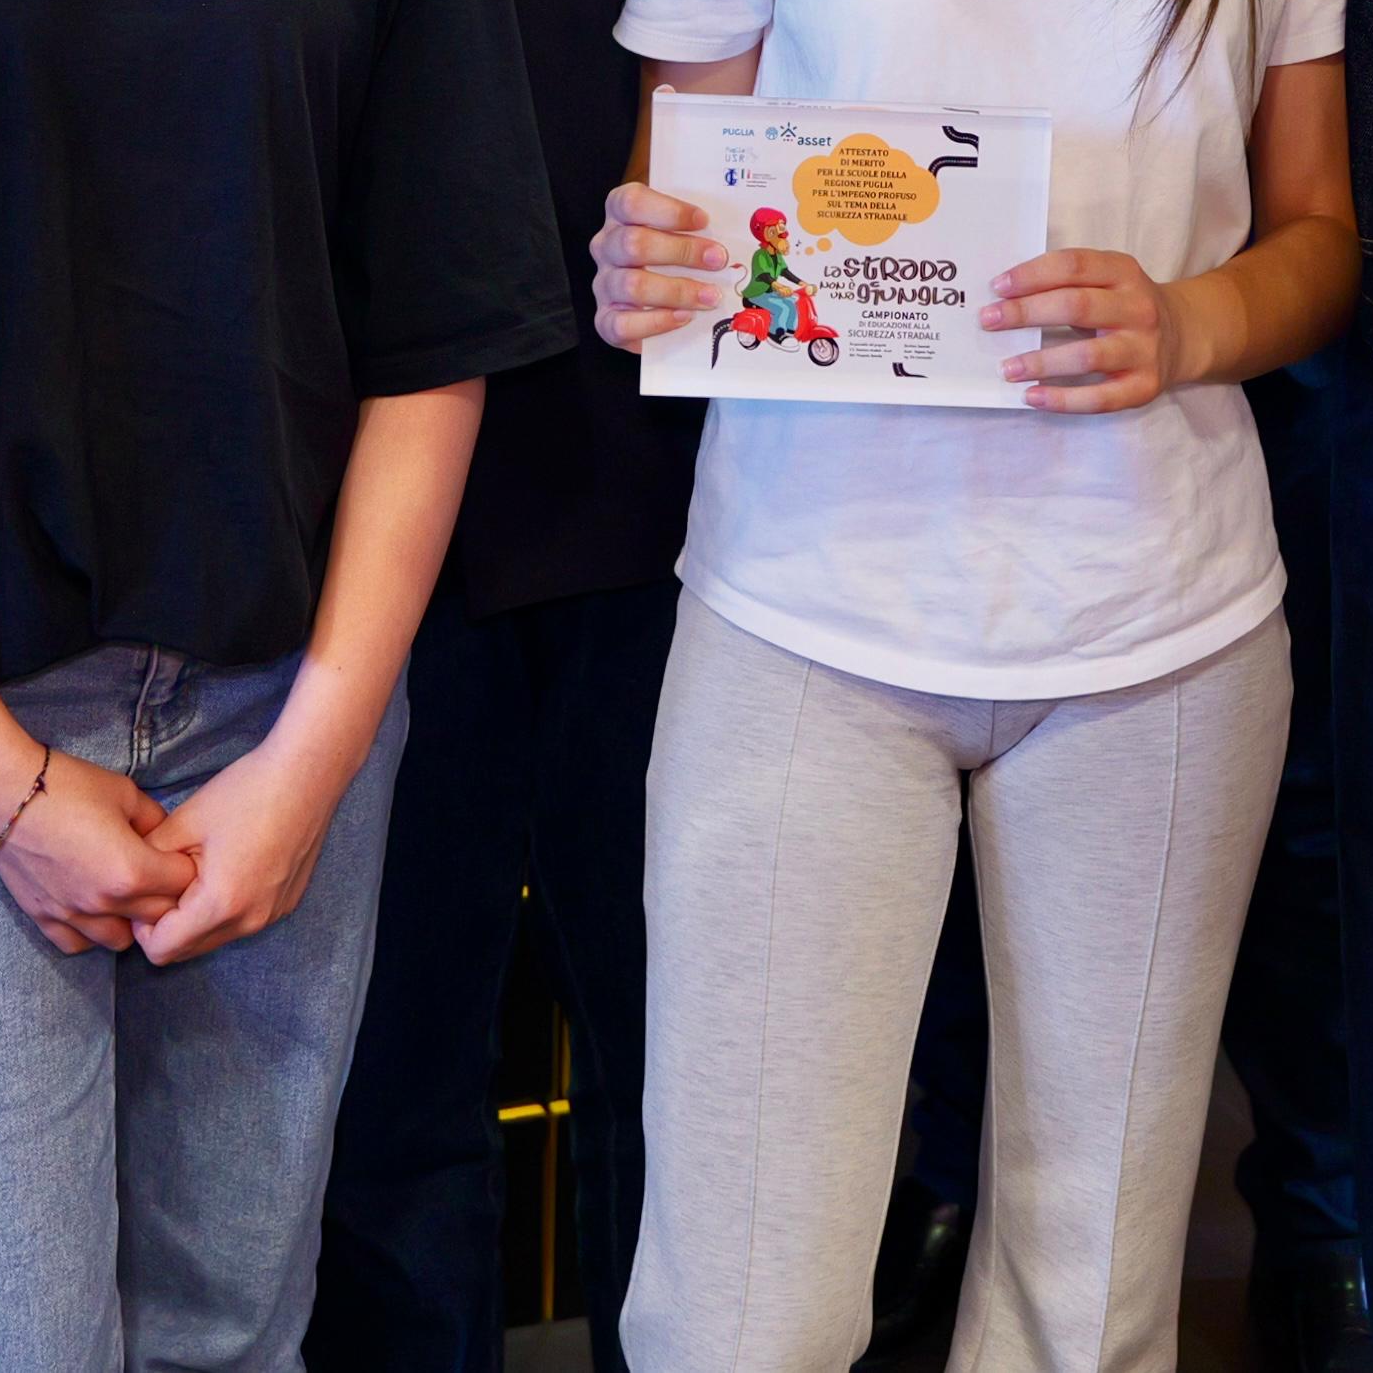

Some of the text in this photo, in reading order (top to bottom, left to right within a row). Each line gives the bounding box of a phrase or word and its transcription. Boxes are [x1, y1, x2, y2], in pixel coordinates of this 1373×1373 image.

[722, 128, 755, 136] PUGLIA
[797, 136, 833, 147] asset
[839, 148, 889, 157] ATTESTATO
[840, 158, 886, 167] DI MERITO
[817, 168, 907, 179] PER LE SCUOLE DELLA
[824, 179, 894, 189] REGIONE PUGLIA
[812, 189, 917, 201] PER L'IMPEGNO PROFUSO
[827, 200, 897, 210] SUL TEMA DELLA
[817, 211, 908, 221] SICUREZZA STRADALE
[861, 311, 929, 321] CAMPIONATO
[867, 321, 912, 329] EDUCAZIONE
[913, 322, 931, 330] ALLA
[848, 330, 941, 341] SICUREZZA STRADALE
